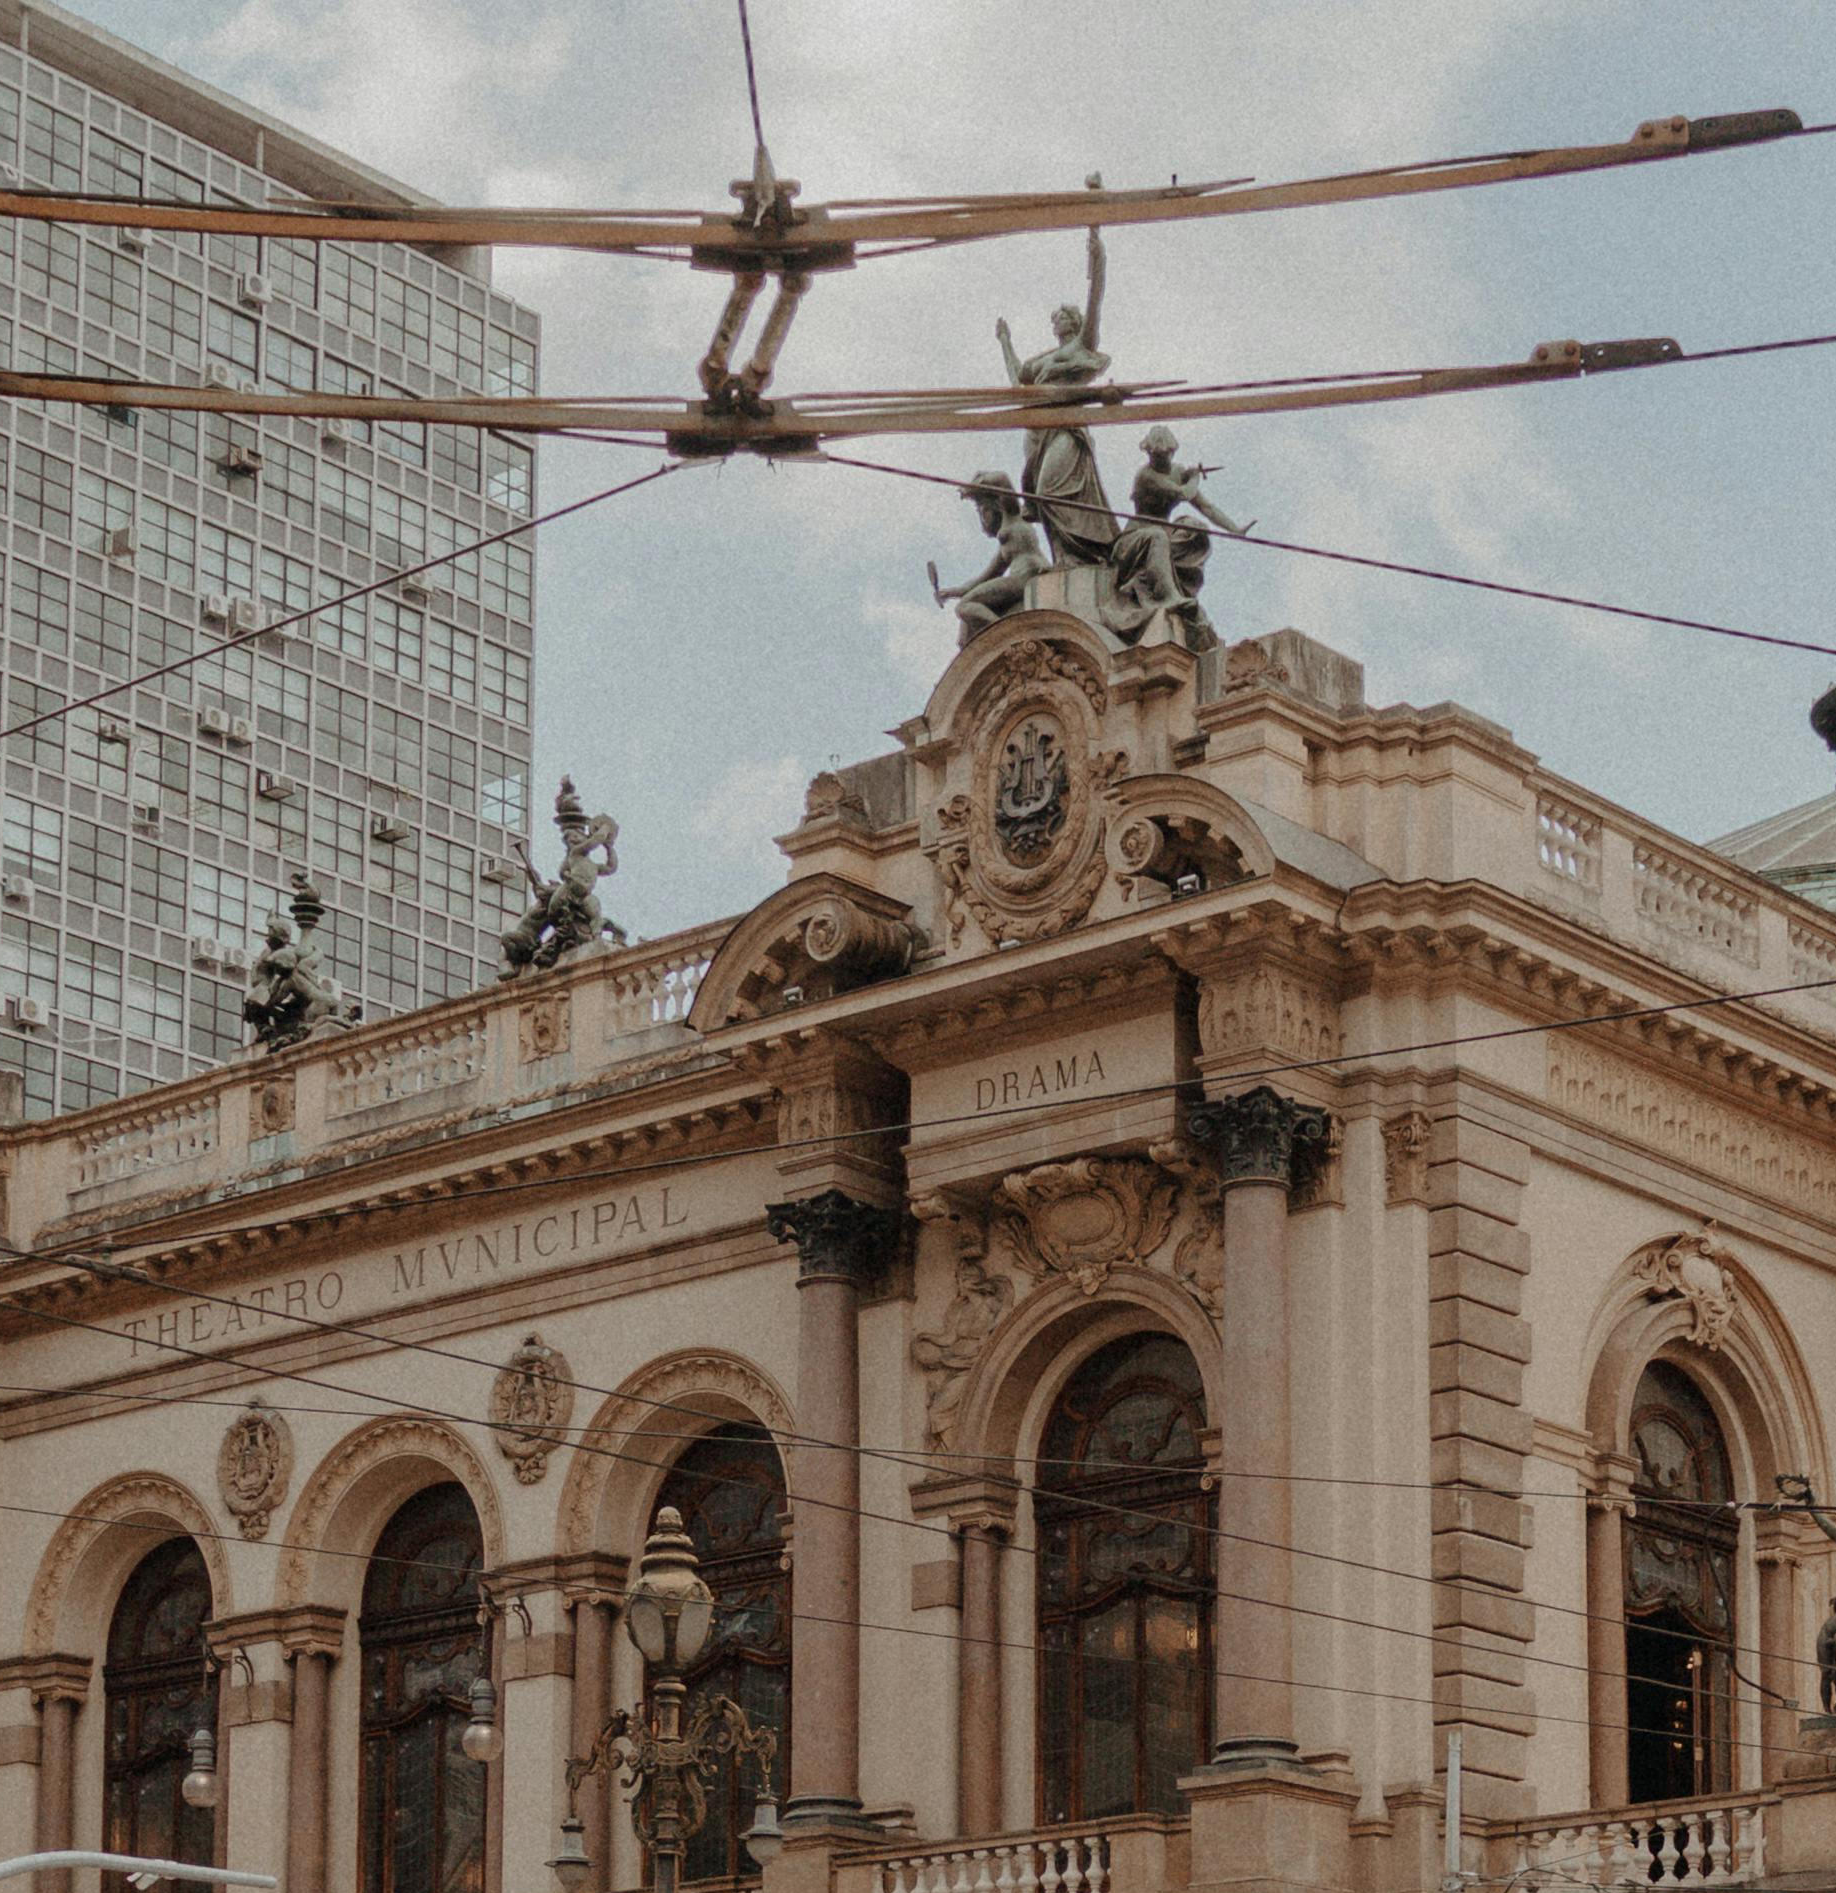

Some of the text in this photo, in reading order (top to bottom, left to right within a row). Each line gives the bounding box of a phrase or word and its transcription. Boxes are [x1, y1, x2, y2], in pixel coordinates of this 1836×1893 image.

[976, 1050, 1106, 1111] DRAMA
[123, 1186, 691, 1358] THEATRO MVNICIPAL
